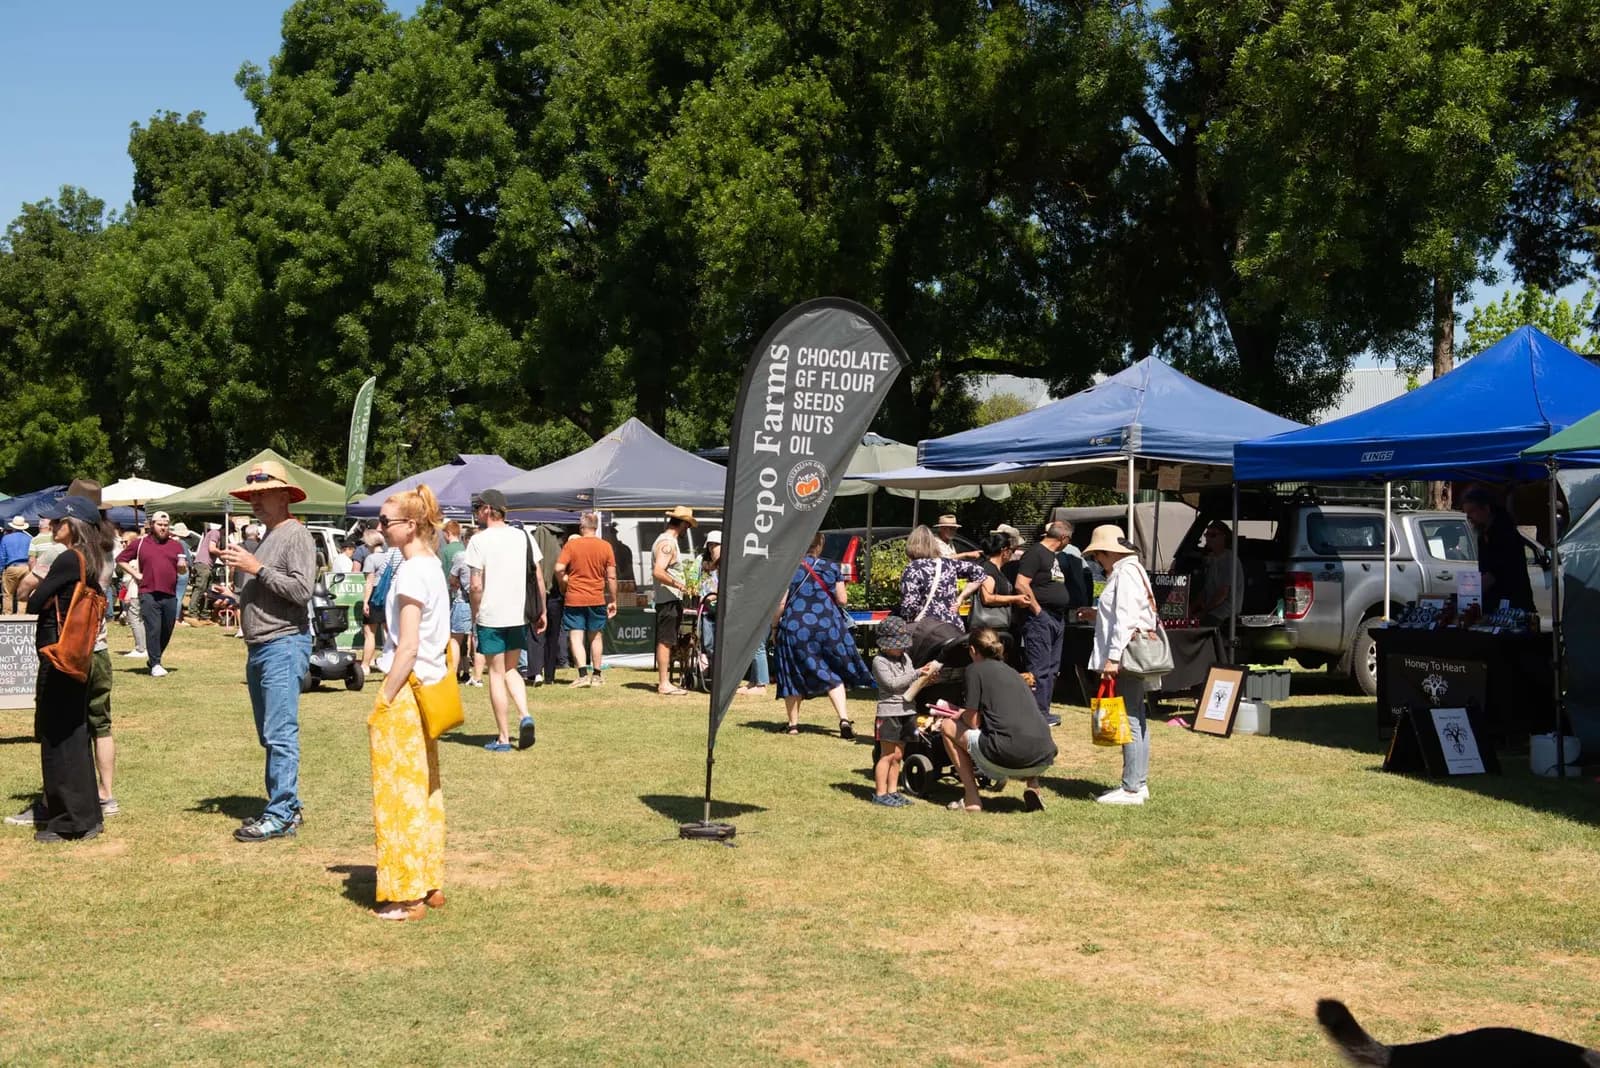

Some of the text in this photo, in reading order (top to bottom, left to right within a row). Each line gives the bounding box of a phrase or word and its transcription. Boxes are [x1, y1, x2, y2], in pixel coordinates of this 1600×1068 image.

[797, 347, 890, 371] CHOCOLATE
[795, 370, 875, 392] GF FLOUR
[793, 392, 844, 413] SEEDS
[791, 413, 834, 434] NUTS
[743, 344, 790, 560] Pepo Farms
[789, 435, 814, 455] OIL
[617, 626, 648, 639] ACIDE
[1404, 658, 1466, 673] Honey To Heart
